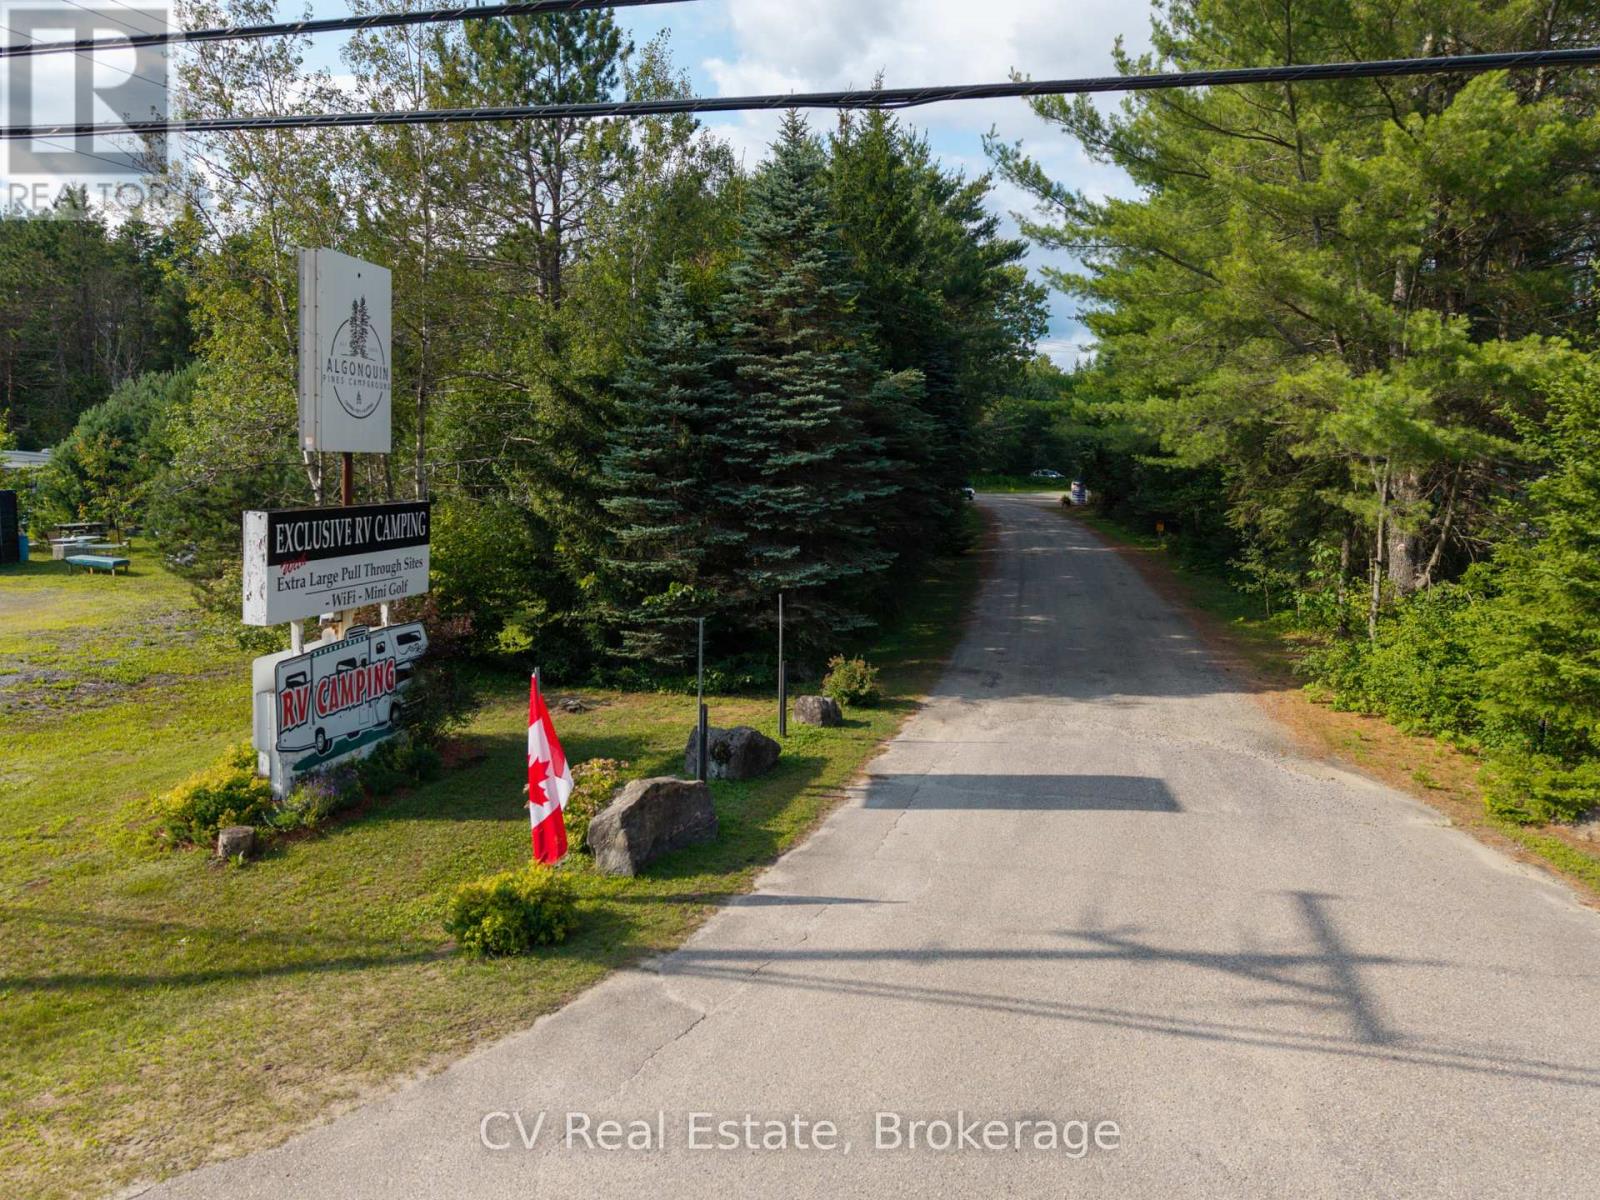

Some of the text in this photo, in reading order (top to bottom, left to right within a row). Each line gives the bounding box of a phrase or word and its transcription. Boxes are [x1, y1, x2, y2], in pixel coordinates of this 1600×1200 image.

[323, 374, 344, 385] PINES
[326, 357, 389, 381] ALGONQUIN
[276, 511, 427, 553] EXCLUSIVE RV CAMPING
[277, 556, 424, 592] Extra Large Pull Through Sites
[332, 590, 356, 607] WiFi
[365, 583, 387, 600] Mini
[389, 579, 409, 595] Golf
[280, 657, 396, 728] RV CAMPING
